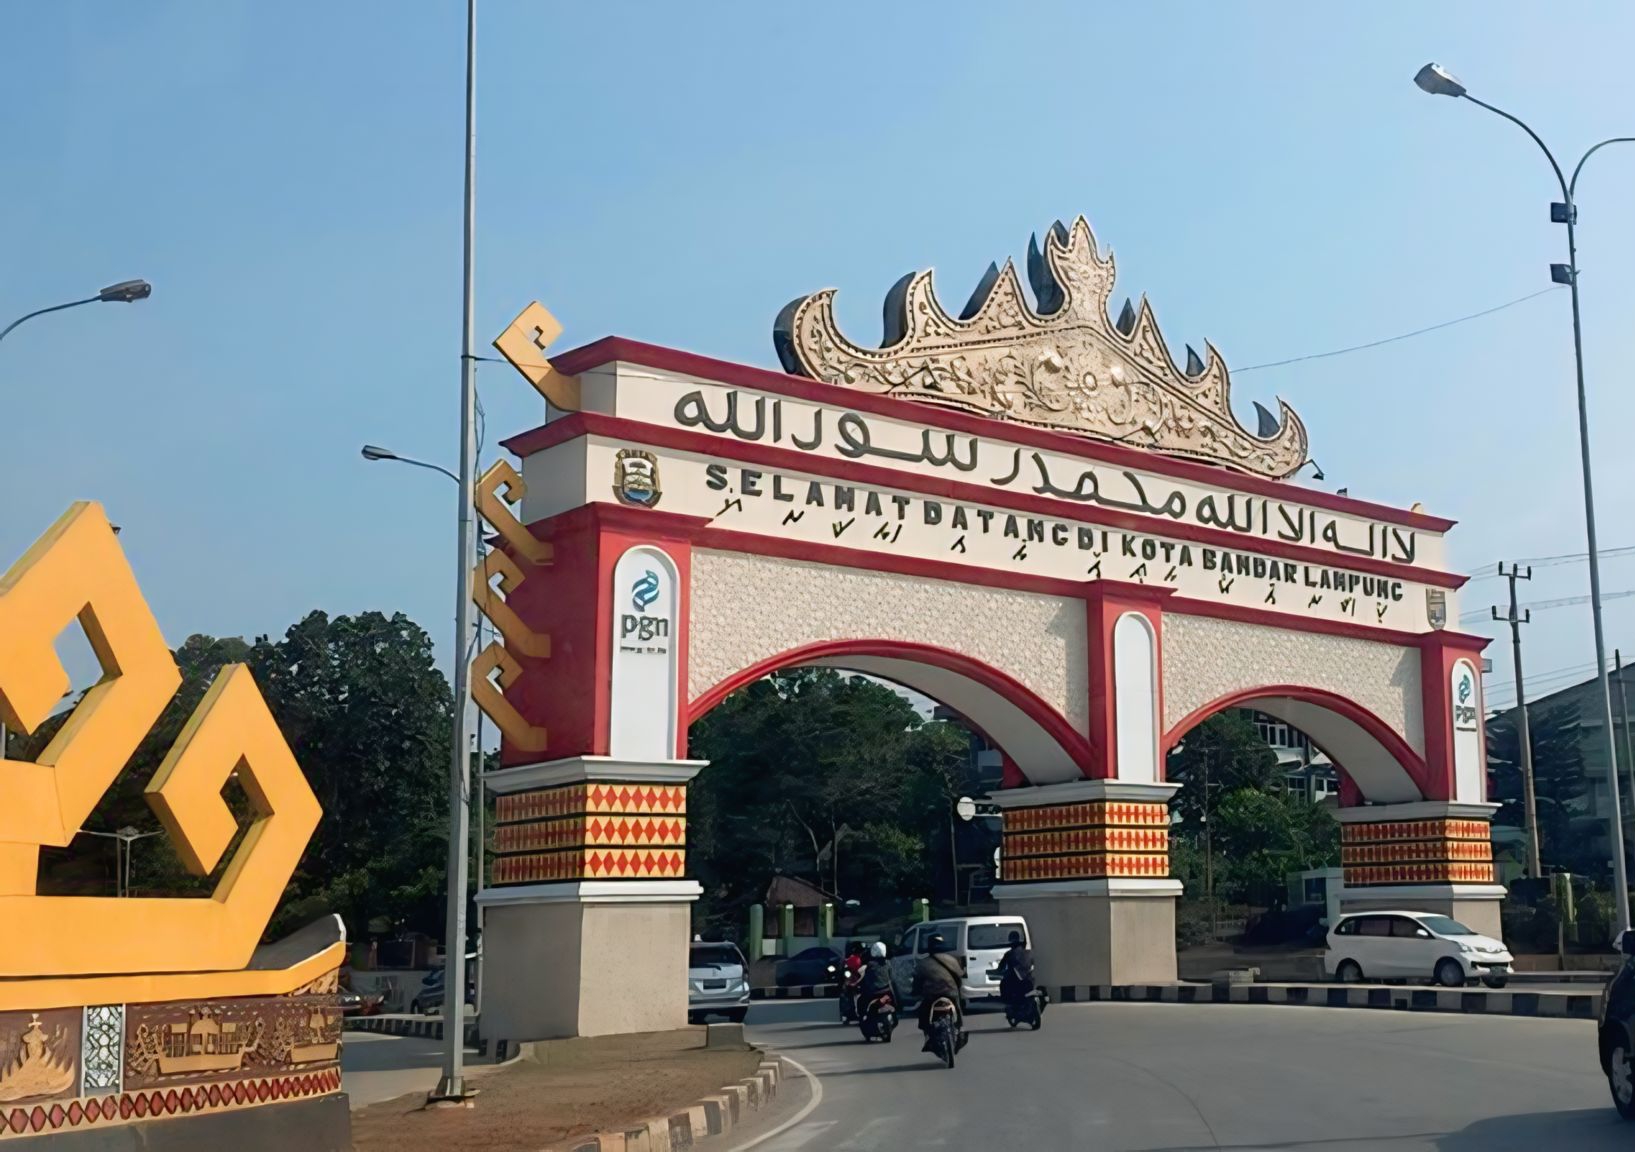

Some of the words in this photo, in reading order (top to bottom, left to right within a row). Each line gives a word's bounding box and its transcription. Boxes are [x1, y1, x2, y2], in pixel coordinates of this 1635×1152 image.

[706, 463, 911, 520] SELAMAT
[923, 500, 1069, 546] DATANG
[1077, 526, 1109, 553] DI
[1121, 534, 1193, 567] KOTA
[1202, 548, 1298, 584] BANDAR
[1303, 565, 1404, 602] LAMPUNG
[621, 614, 669, 641] pgn
